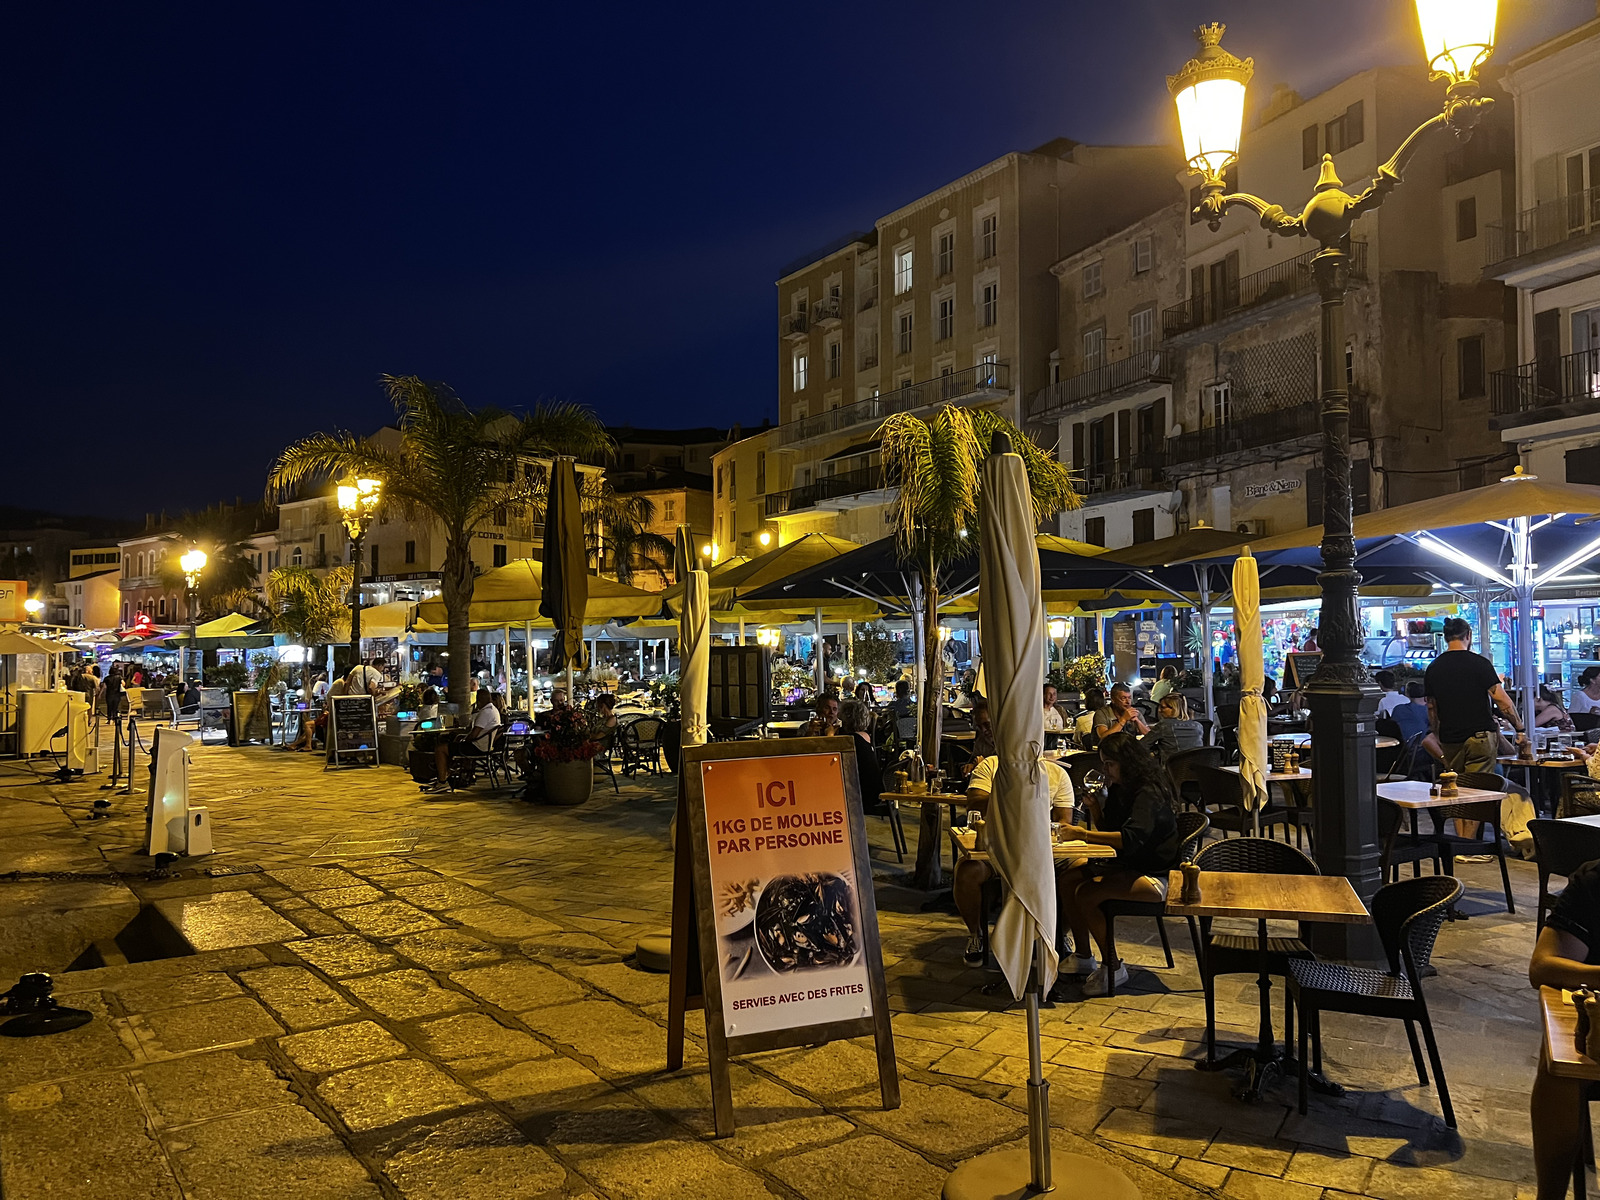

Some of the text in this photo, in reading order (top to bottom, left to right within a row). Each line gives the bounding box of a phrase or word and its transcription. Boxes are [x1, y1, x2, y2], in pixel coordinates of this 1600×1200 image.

[756, 780, 796, 808] ICI
[713, 811, 844, 835] 1KG DE MOULES
[717, 830, 843, 854] PAR PERSONNE
[732, 983, 864, 1010] SERVIES AVEC DES FRITES
